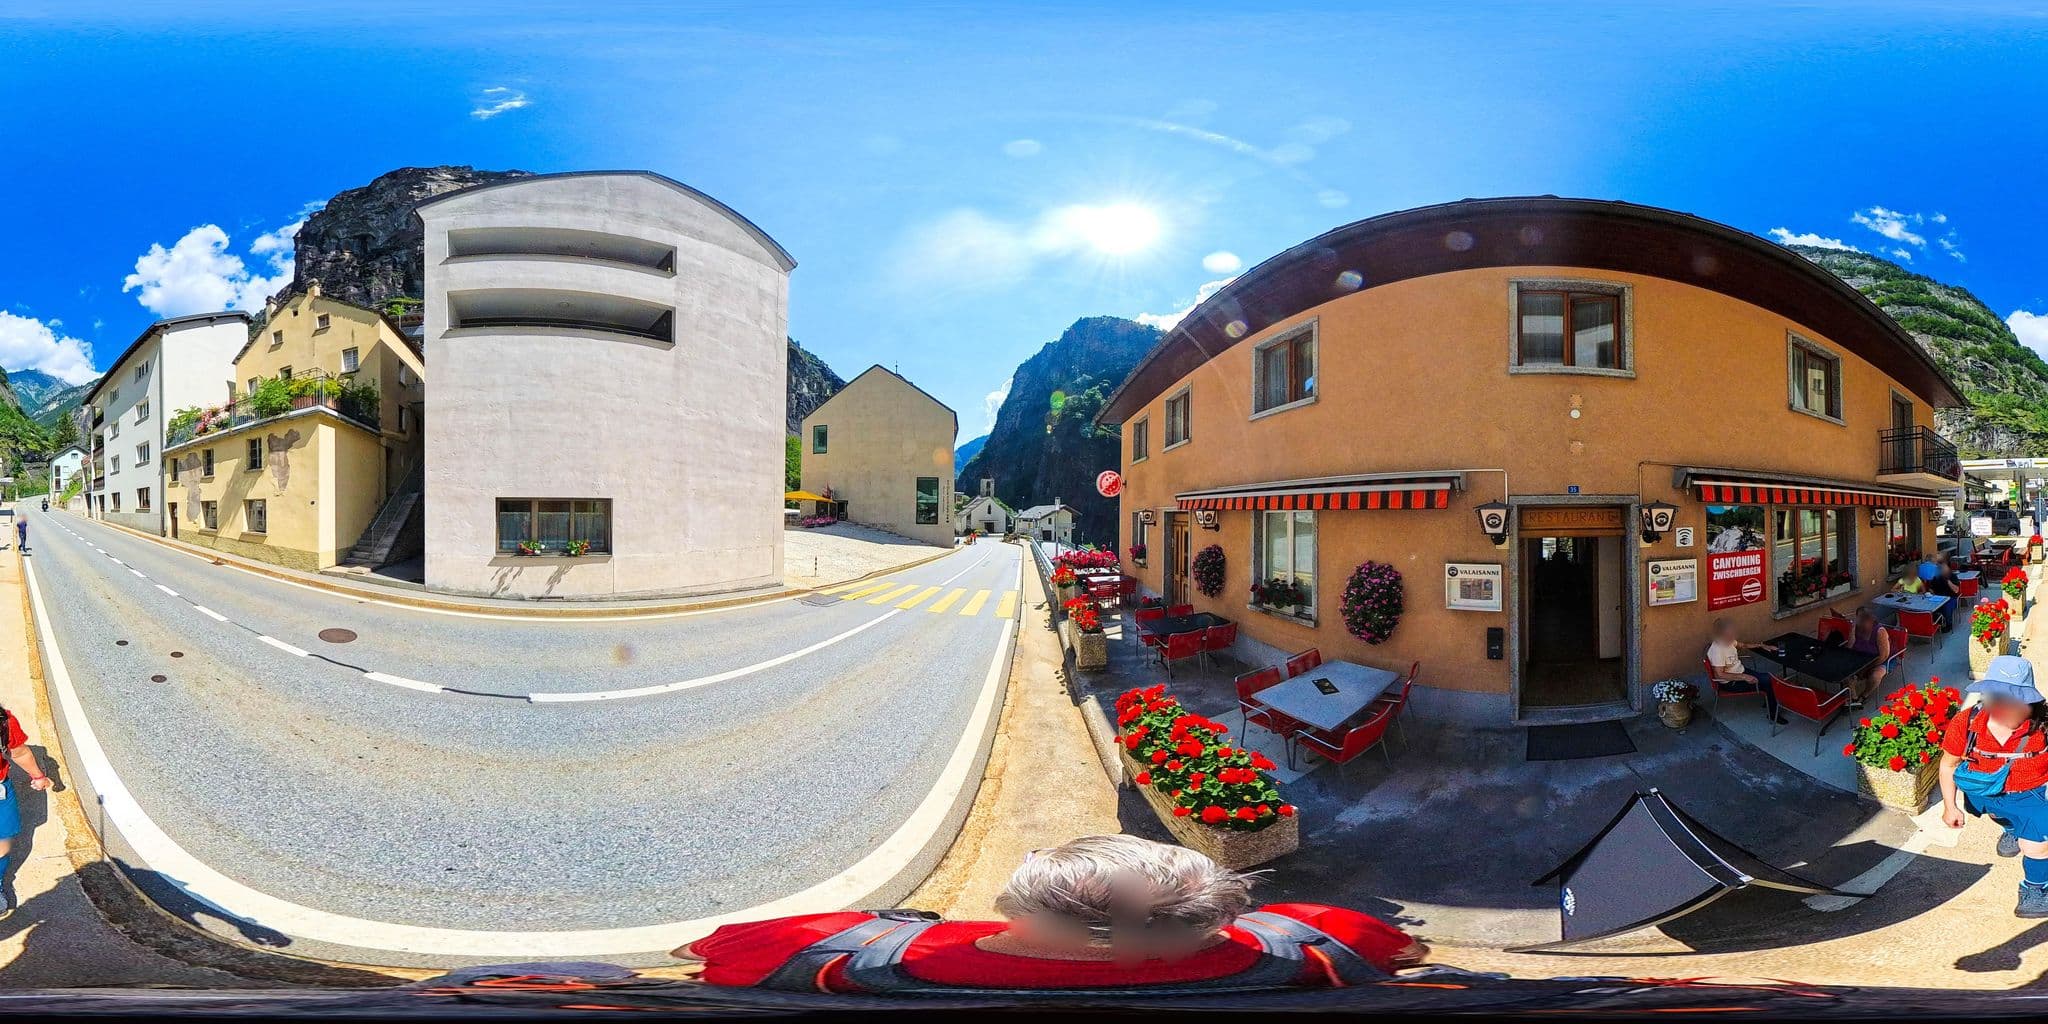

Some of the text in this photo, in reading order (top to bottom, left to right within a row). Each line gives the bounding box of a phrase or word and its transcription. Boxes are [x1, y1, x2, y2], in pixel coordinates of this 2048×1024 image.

[2018, 459, 2033, 469] eni
[1713, 554, 1761, 570] CANYONING
[1713, 565, 1761, 580] ZWISCHBERGEN
